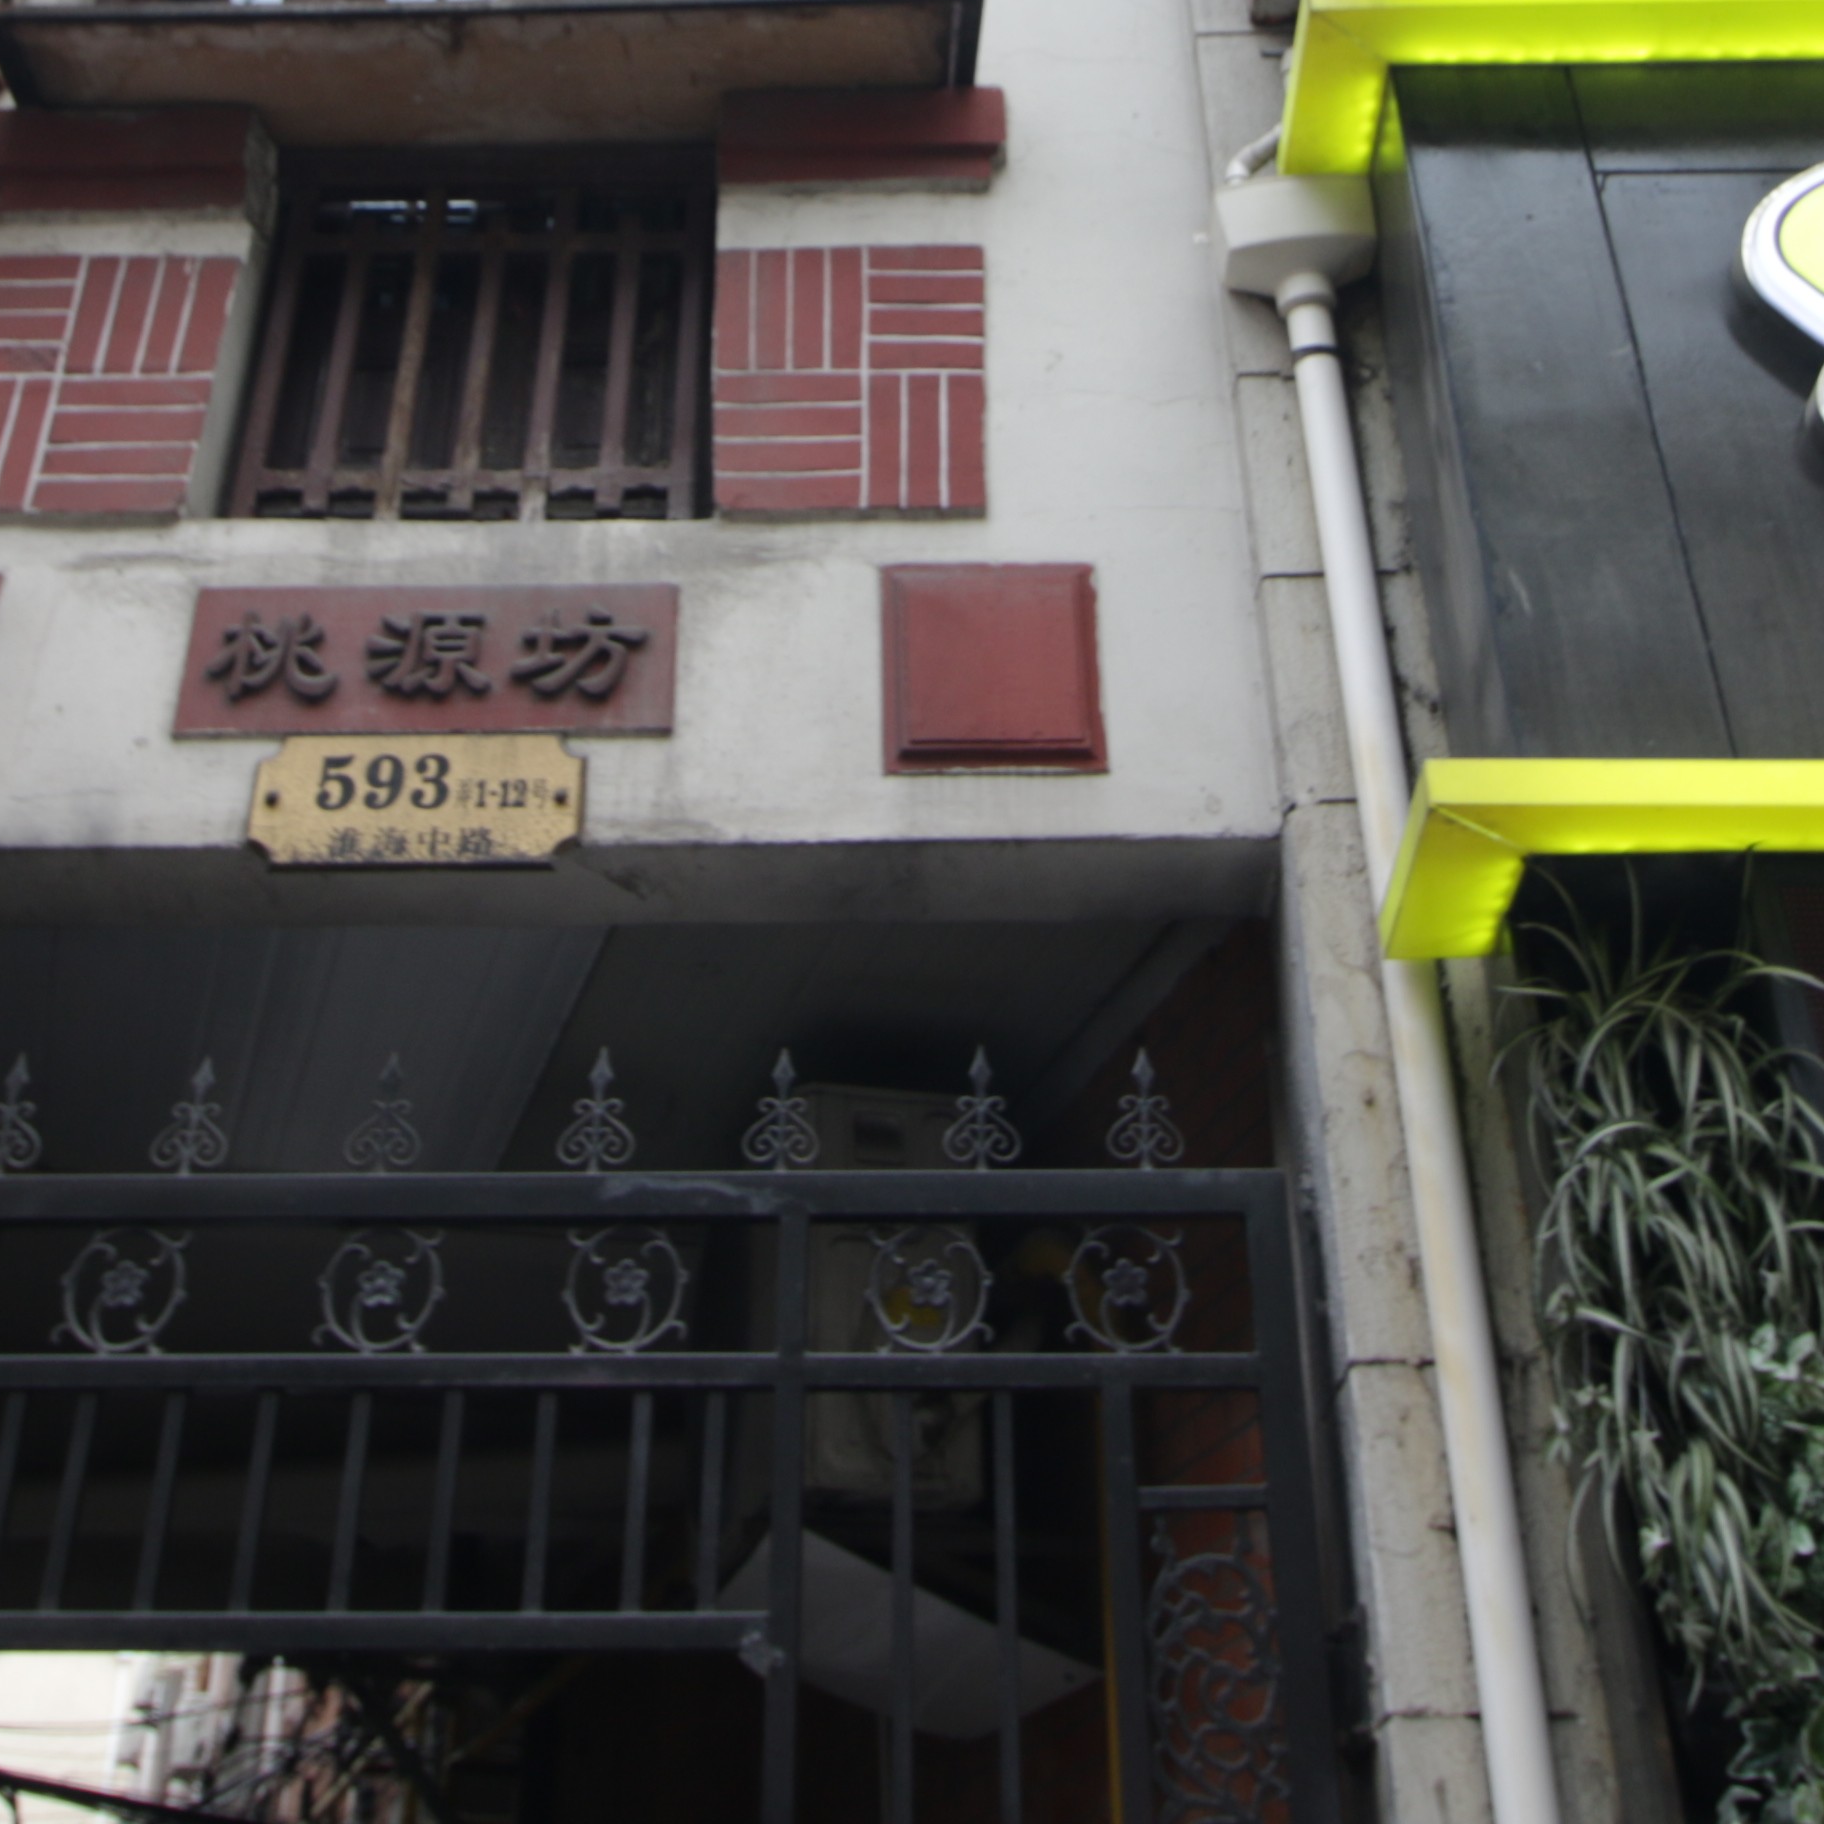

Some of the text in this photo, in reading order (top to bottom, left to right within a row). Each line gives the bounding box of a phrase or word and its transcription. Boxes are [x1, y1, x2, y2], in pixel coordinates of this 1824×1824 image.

[205, 606, 649, 702] 桃源坊
[327, 826, 494, 858] 淮海中路
